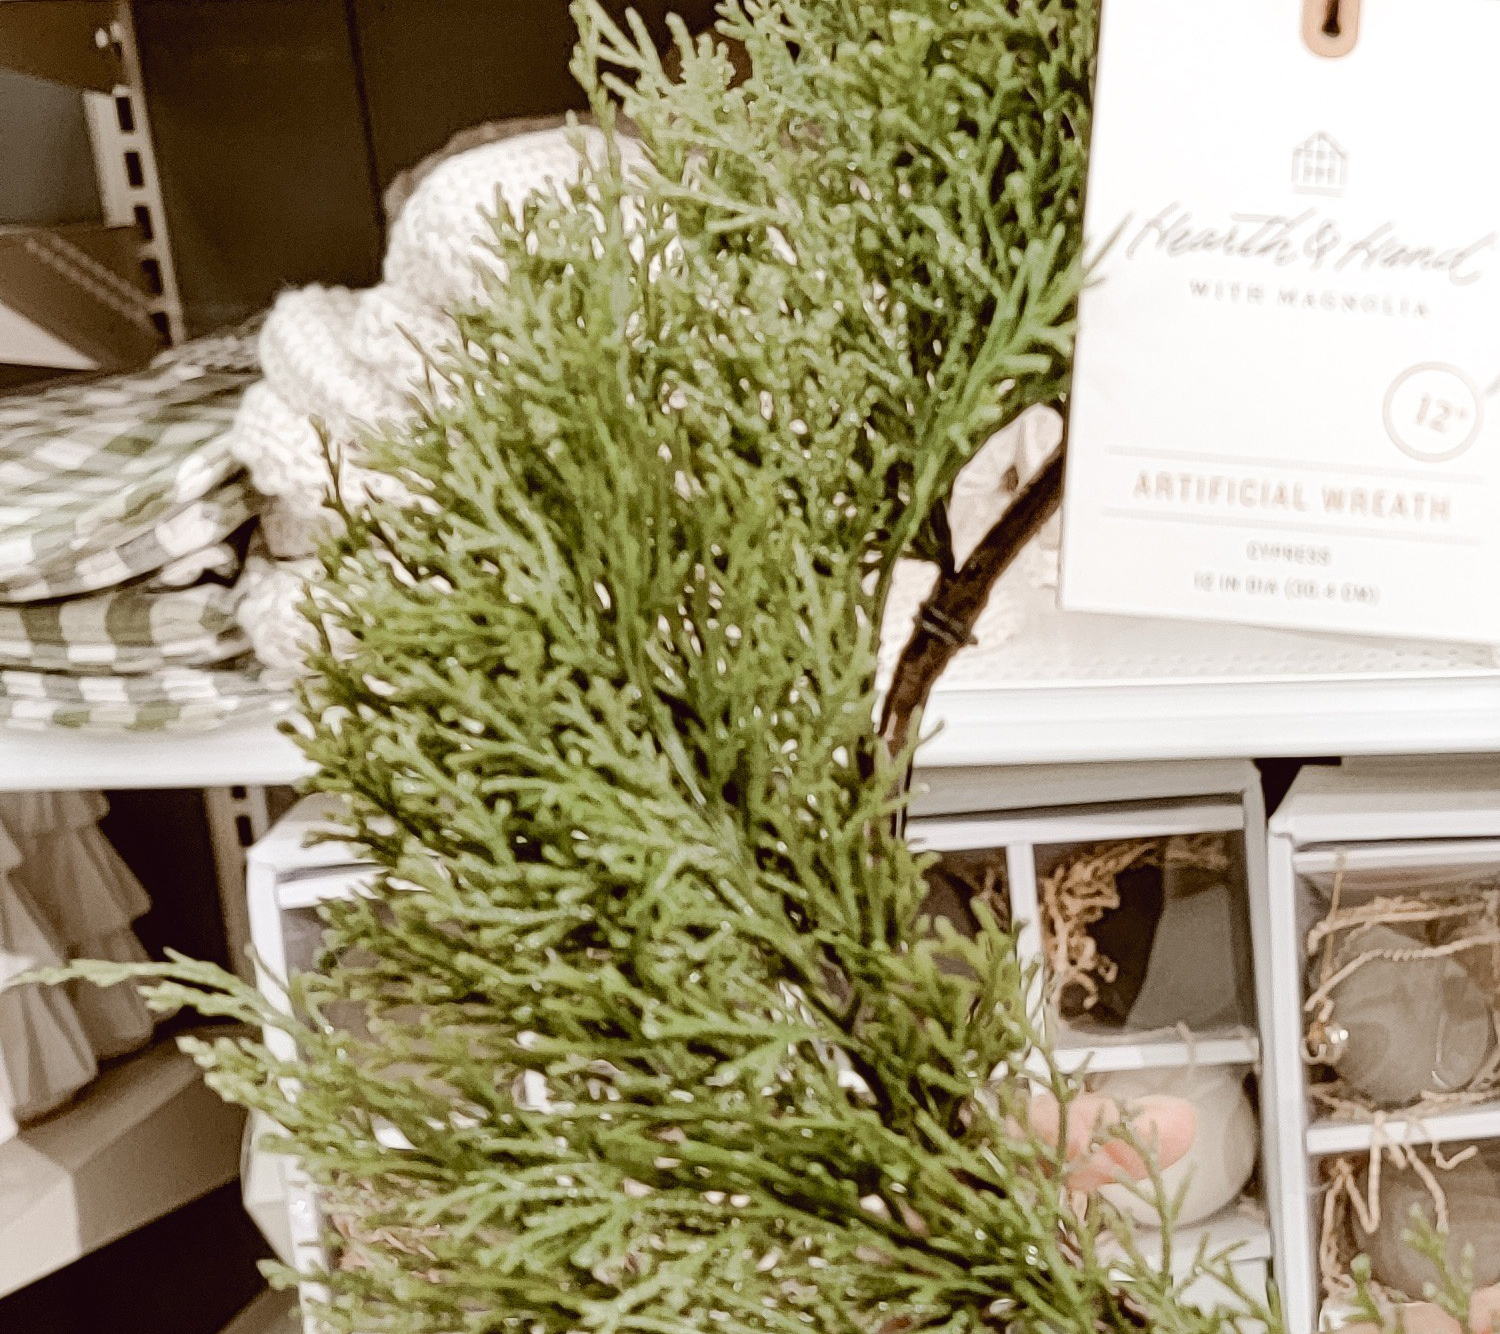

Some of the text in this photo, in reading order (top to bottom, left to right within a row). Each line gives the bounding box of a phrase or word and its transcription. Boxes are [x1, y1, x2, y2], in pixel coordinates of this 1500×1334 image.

[1125, 202, 1500, 287] Hearth & Hand
[1189, 278, 1432, 320] WITH MAGNOLIA
[1132, 469, 1453, 523] ARTIFICIAL WREATH
